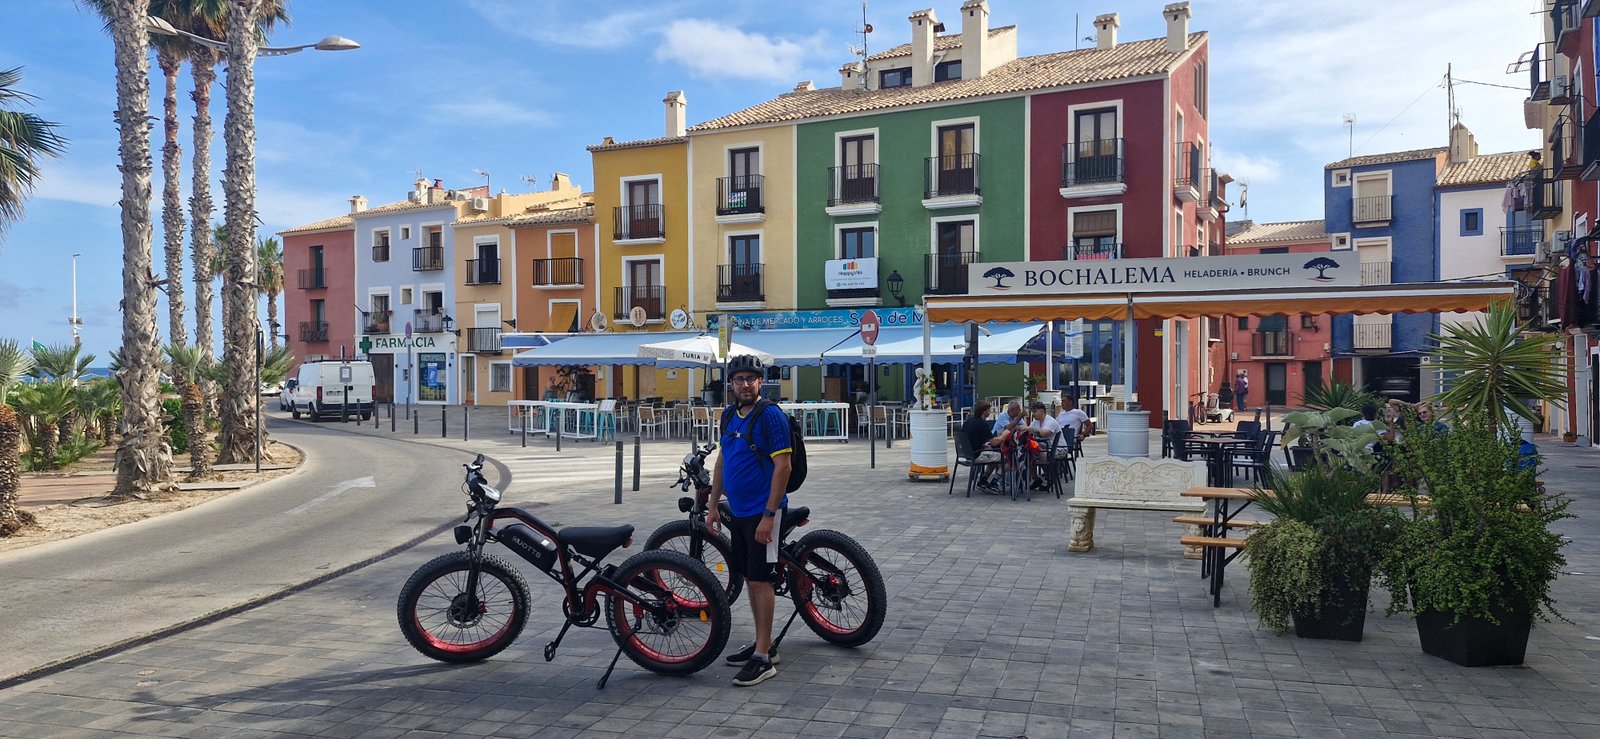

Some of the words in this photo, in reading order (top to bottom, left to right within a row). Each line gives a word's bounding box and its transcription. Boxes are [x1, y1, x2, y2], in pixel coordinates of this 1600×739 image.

[1024, 266, 1176, 287] BOCHALEMA
[1184, 268, 1238, 279] HELADERÍA
[1247, 266, 1291, 277] BRUNCH
[762, 317, 800, 325] MERCADO
[808, 316, 844, 324] ARROCES
[888, 312, 907, 324] de
[376, 337, 435, 348] FARMACIA
[682, 352, 701, 360] TURIA
